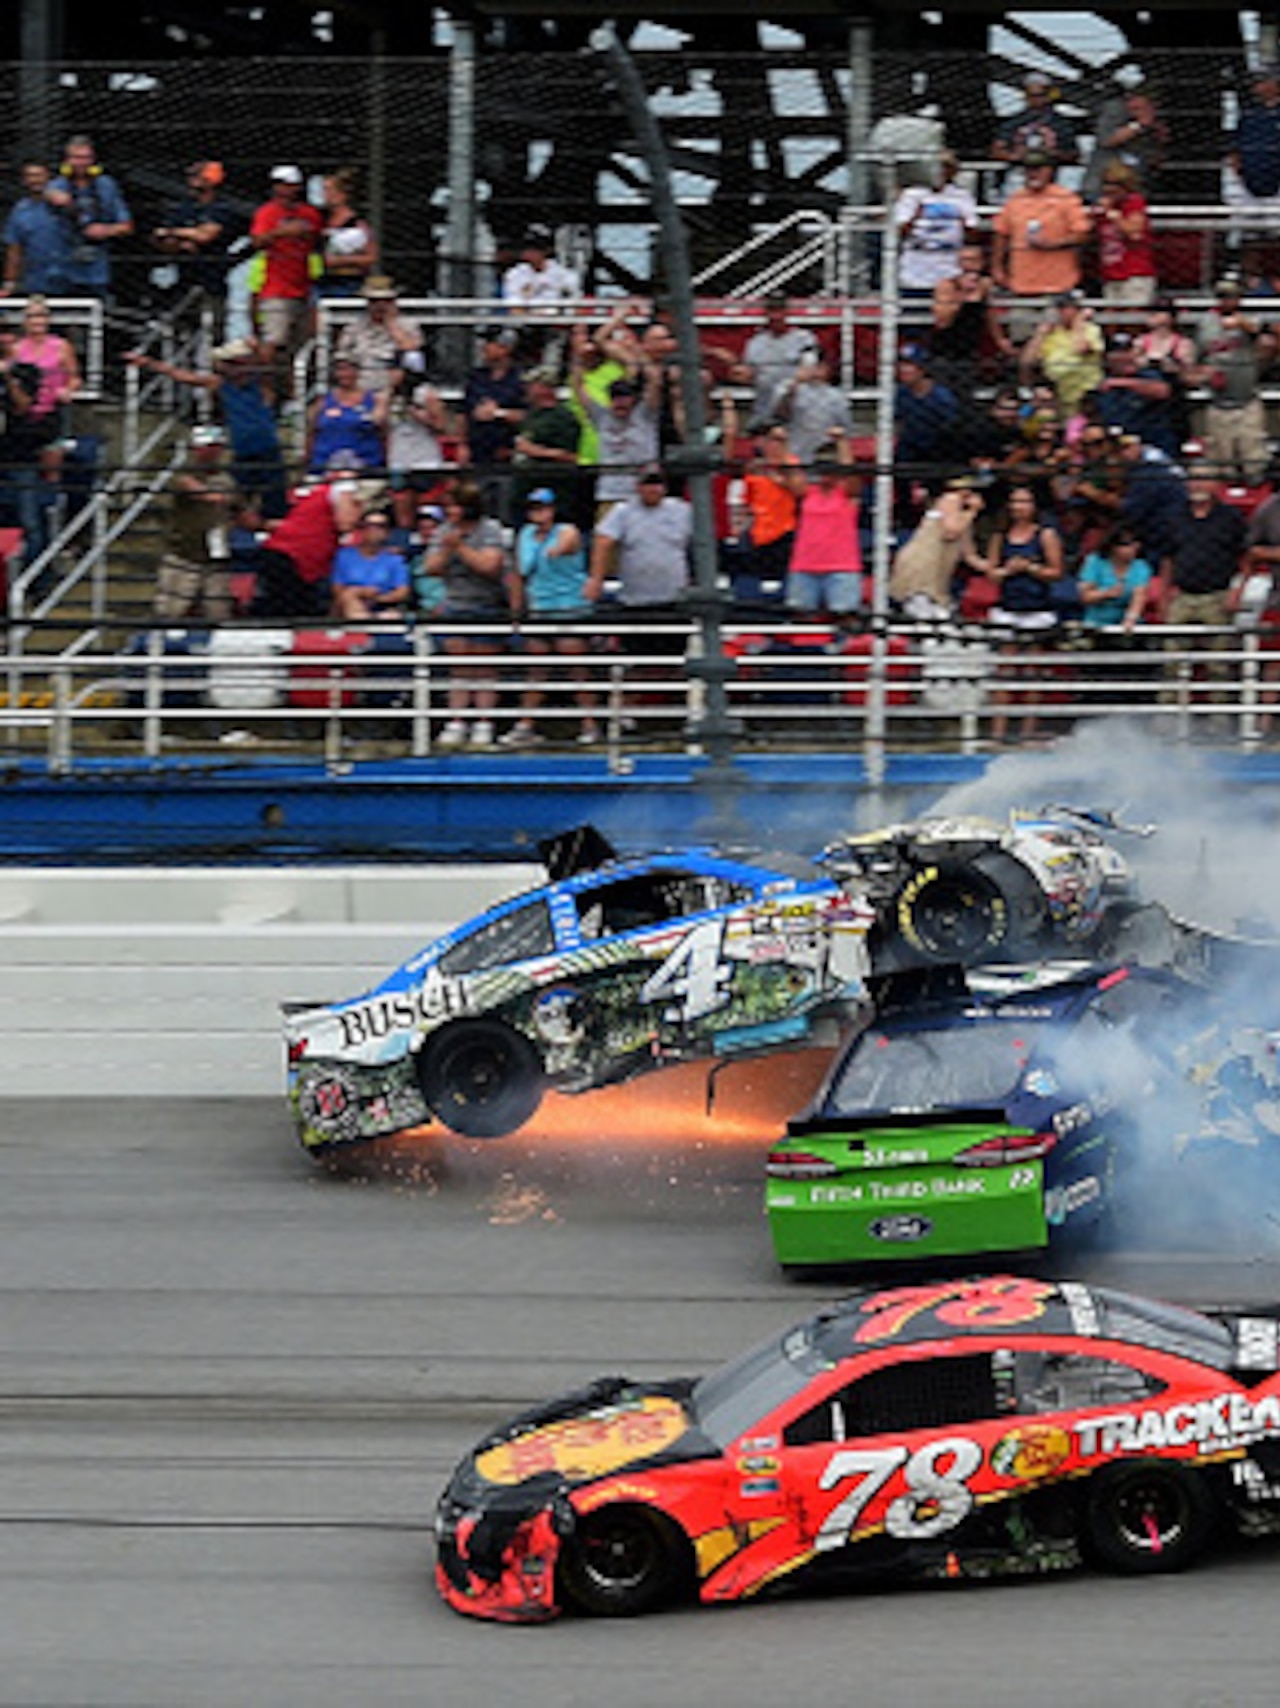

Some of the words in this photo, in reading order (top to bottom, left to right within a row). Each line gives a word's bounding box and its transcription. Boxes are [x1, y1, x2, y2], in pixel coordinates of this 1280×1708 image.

[337, 978, 471, 1050] BUSCH
[642, 918, 734, 1023] 4
[852, 1275, 1060, 1345] 78
[814, 1438, 983, 1551] 78
